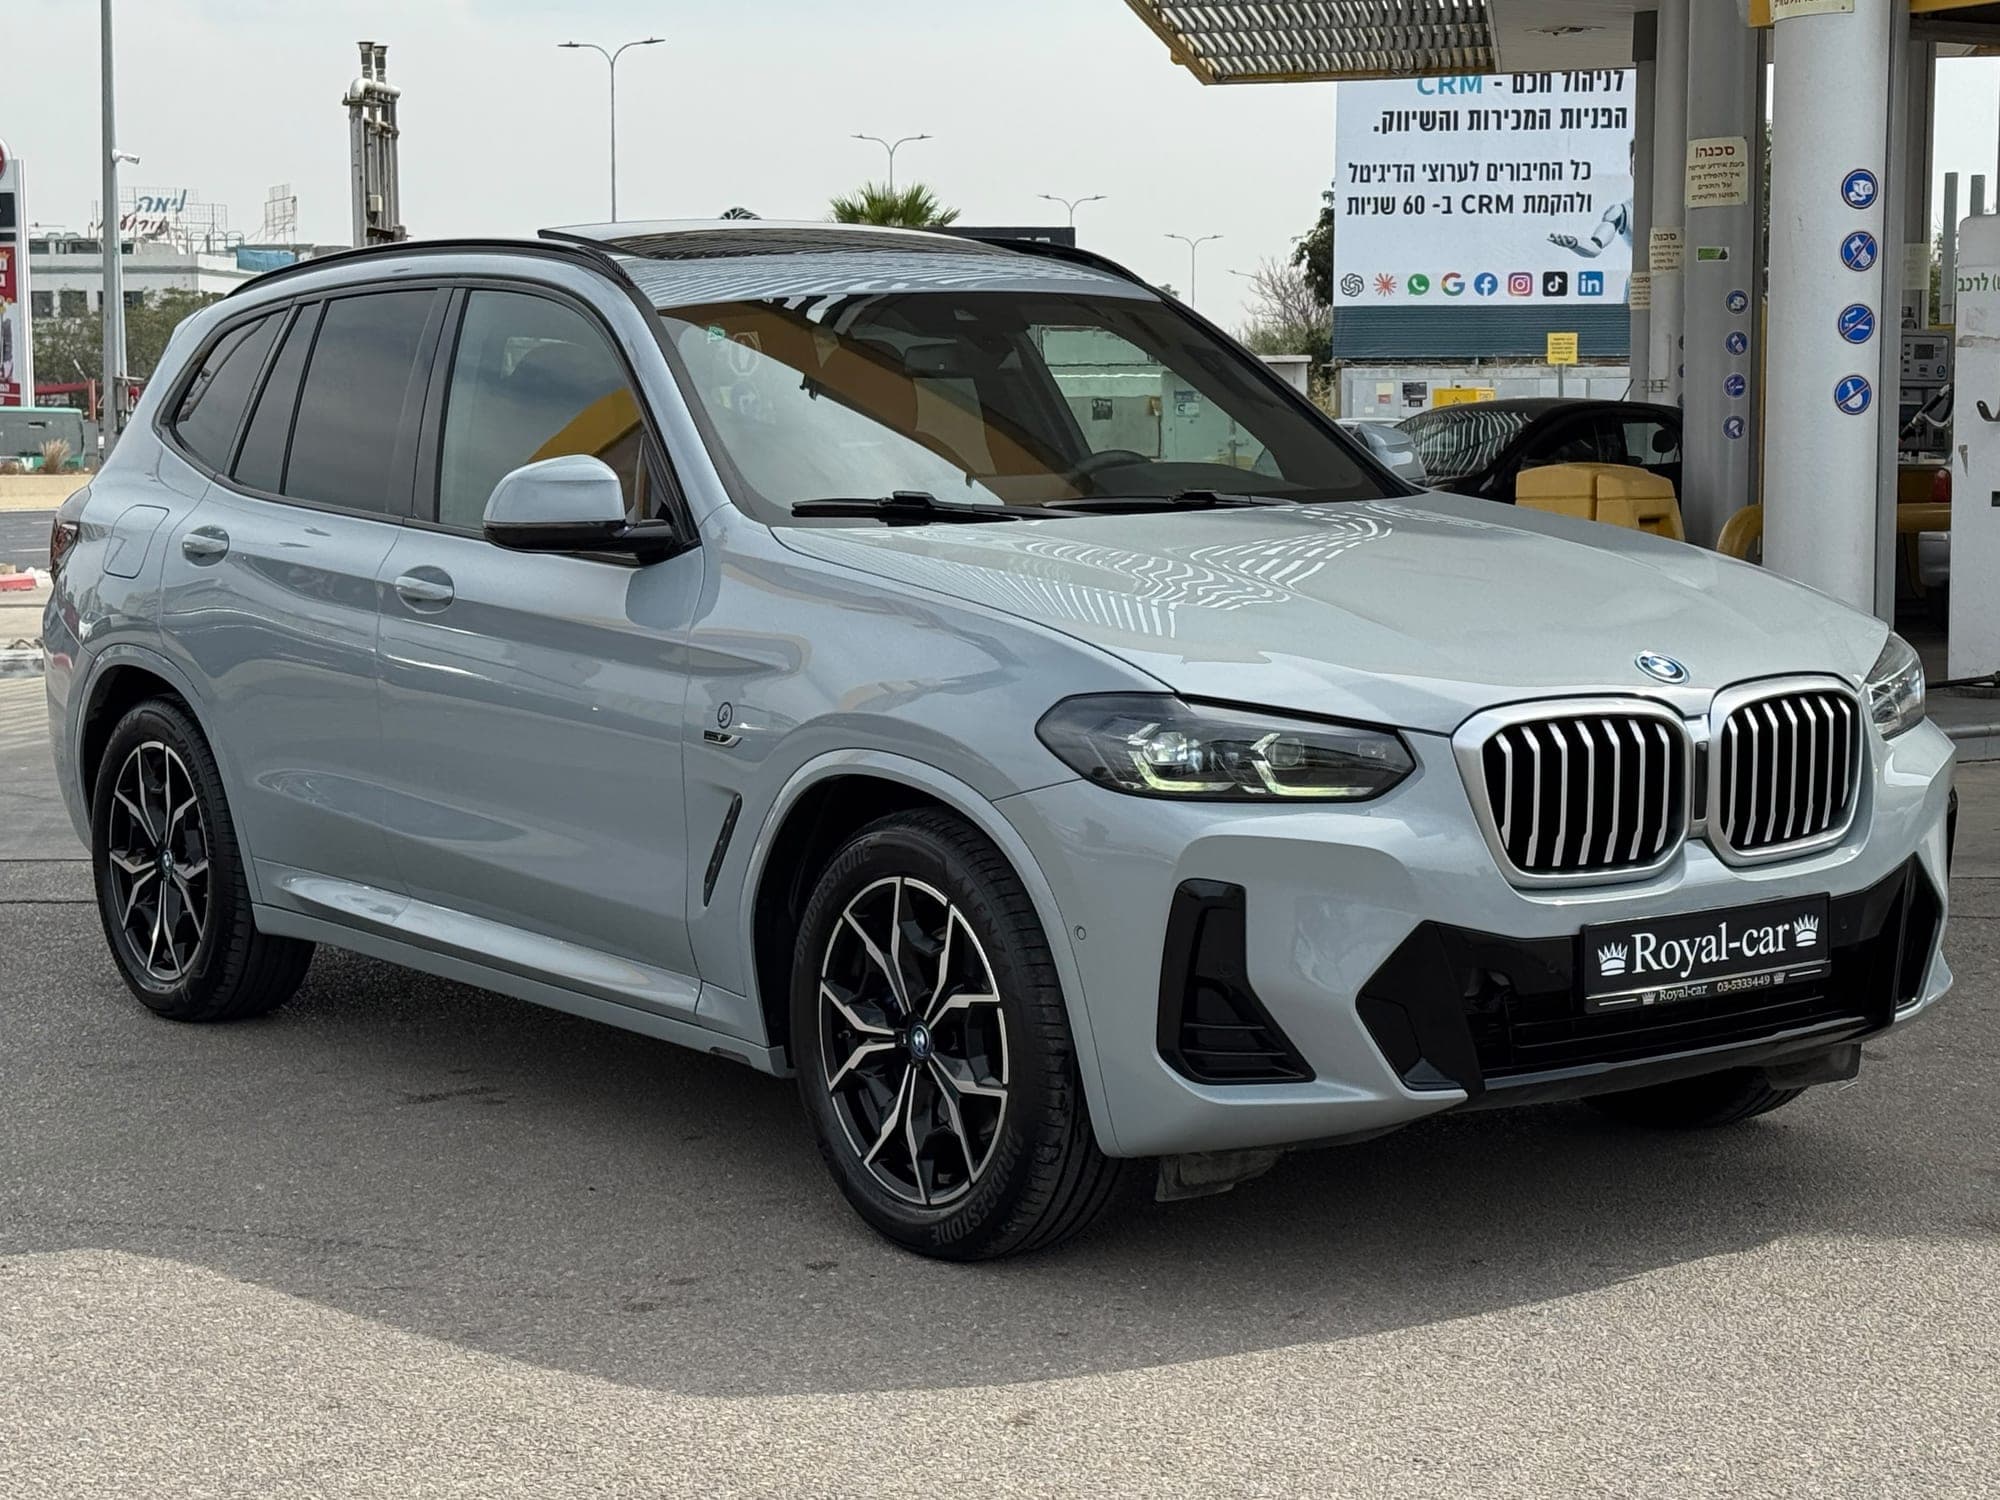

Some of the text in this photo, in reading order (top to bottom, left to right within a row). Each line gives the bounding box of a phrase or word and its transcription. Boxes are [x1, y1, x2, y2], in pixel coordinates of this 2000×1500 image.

[1417, 75, 1482, 96] CRM
[1512, 72, 1552, 94] חכם
[1563, 71, 1625, 93] לניהול
[1373, 107, 1628, 135] הפניות המכירות והשיווק.
[1695, 145, 1735, 159] סכנה!
[1348, 159, 1592, 184] כל החיבורים לערוצי הדיגיטל
[1346, 196, 1396, 216] שניות
[1402, 195, 1425, 215] 60
[1461, 193, 1514, 215] CRM
[1523, 191, 1592, 217] ולהקמת
[1957, 271, 1989, 293] לרכב
[1631, 921, 1790, 978] Royal-car
[1659, 974, 1771, 1001] Royal-car 03-5333449
